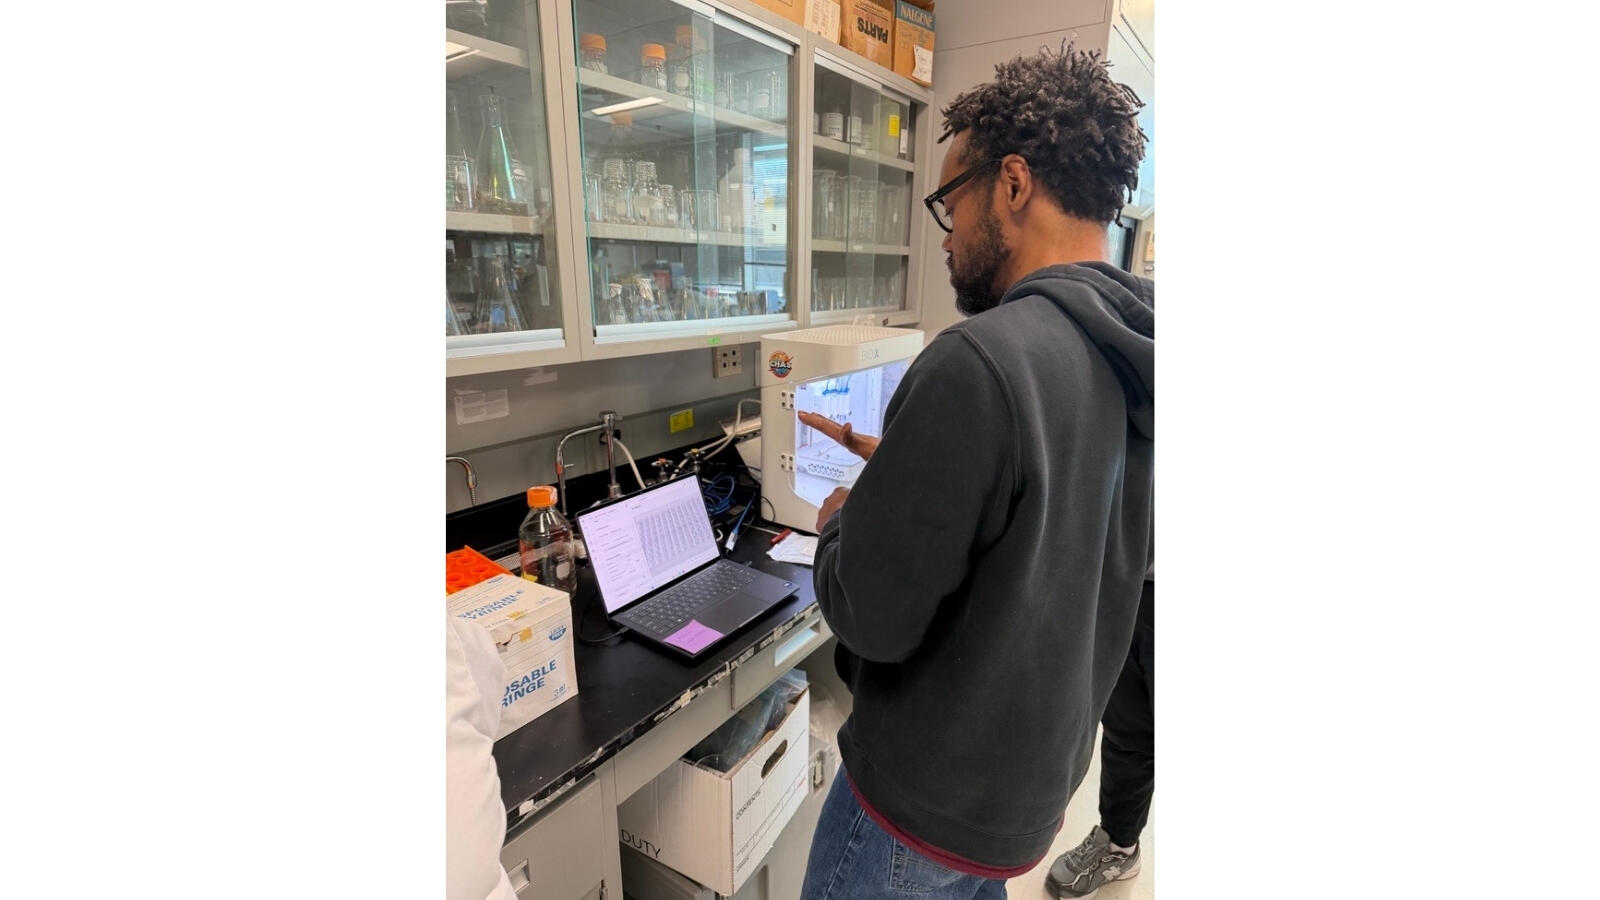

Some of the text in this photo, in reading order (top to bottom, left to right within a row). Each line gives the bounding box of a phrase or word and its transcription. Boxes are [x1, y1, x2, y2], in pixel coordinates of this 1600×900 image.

[900, 6, 933, 26] NALGENE
[857, 17, 888, 44] PARTS
[620, 829, 661, 859] DUTY
